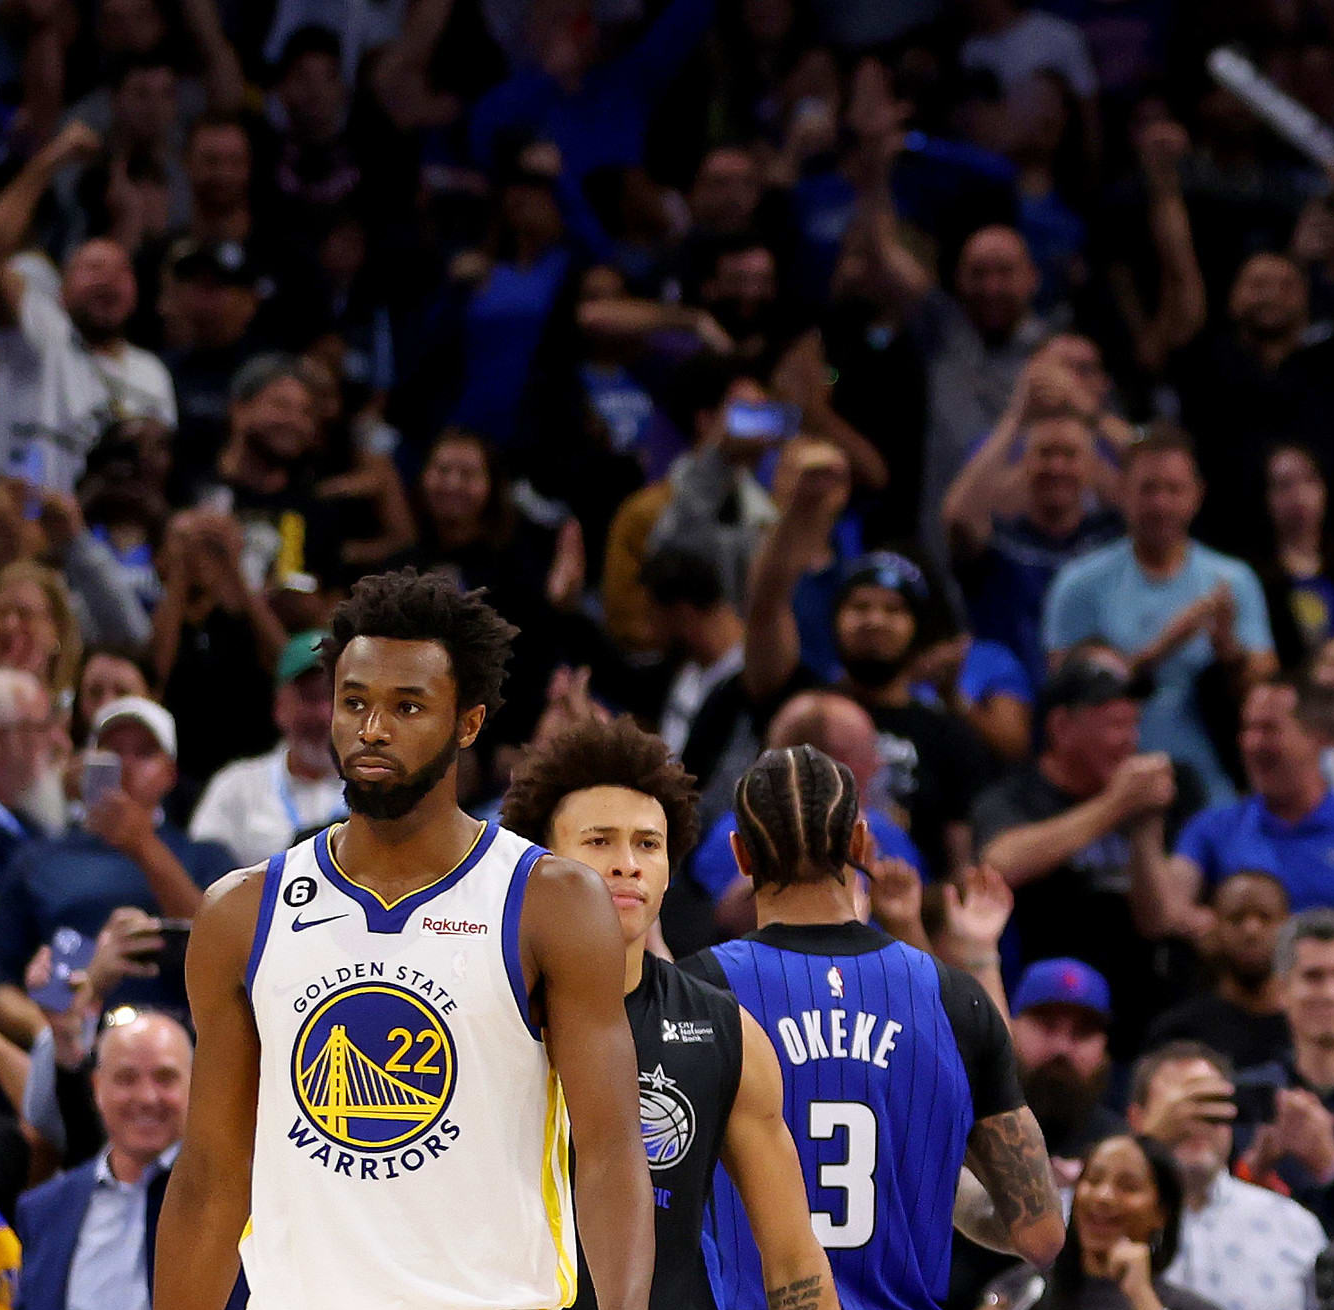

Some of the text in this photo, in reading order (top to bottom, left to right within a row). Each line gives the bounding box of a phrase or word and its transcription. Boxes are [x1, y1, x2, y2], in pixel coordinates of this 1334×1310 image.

[291, 880, 310, 904] 6
[422, 917, 488, 935] Rakuten
[293, 962, 458, 1015] GOLDEN STATE
[385, 1027, 443, 1075] 22
[777, 1009, 903, 1069] OKEKE
[287, 1115, 461, 1181] WARRIORS
[809, 1101, 878, 1249] 3
